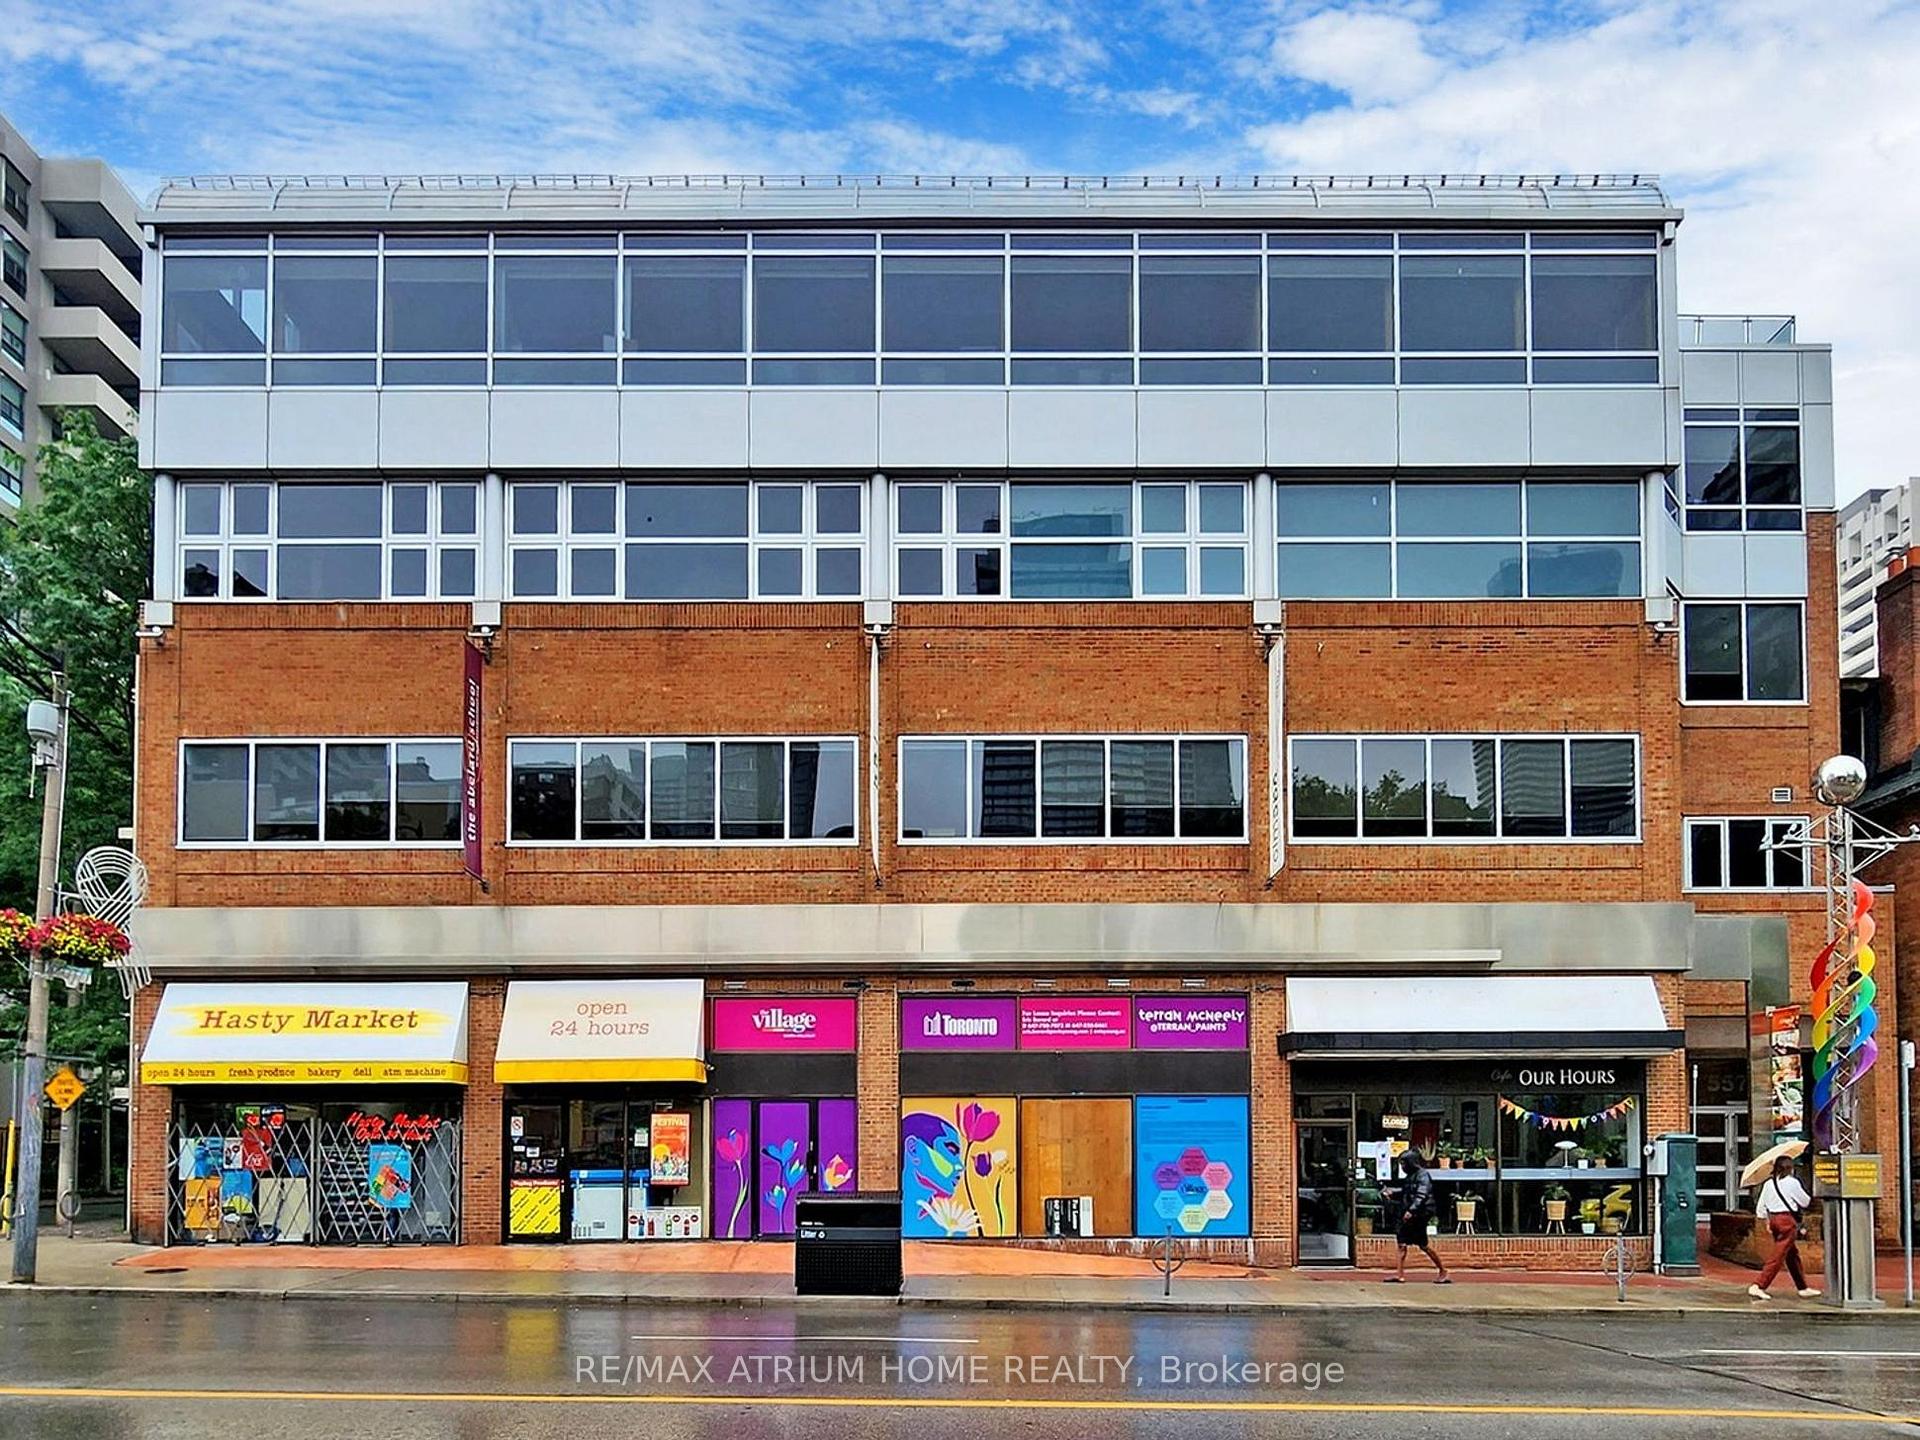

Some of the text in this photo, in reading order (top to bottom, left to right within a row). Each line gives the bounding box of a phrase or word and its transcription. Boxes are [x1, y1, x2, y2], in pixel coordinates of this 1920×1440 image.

[576, 1001, 628, 1018] open
[200, 1009, 419, 1034] Hasty Market
[550, 1020, 650, 1036] 24 hours
[147, 1067, 447, 1079] open 24 hours fresh produce bakery deli atm machine
